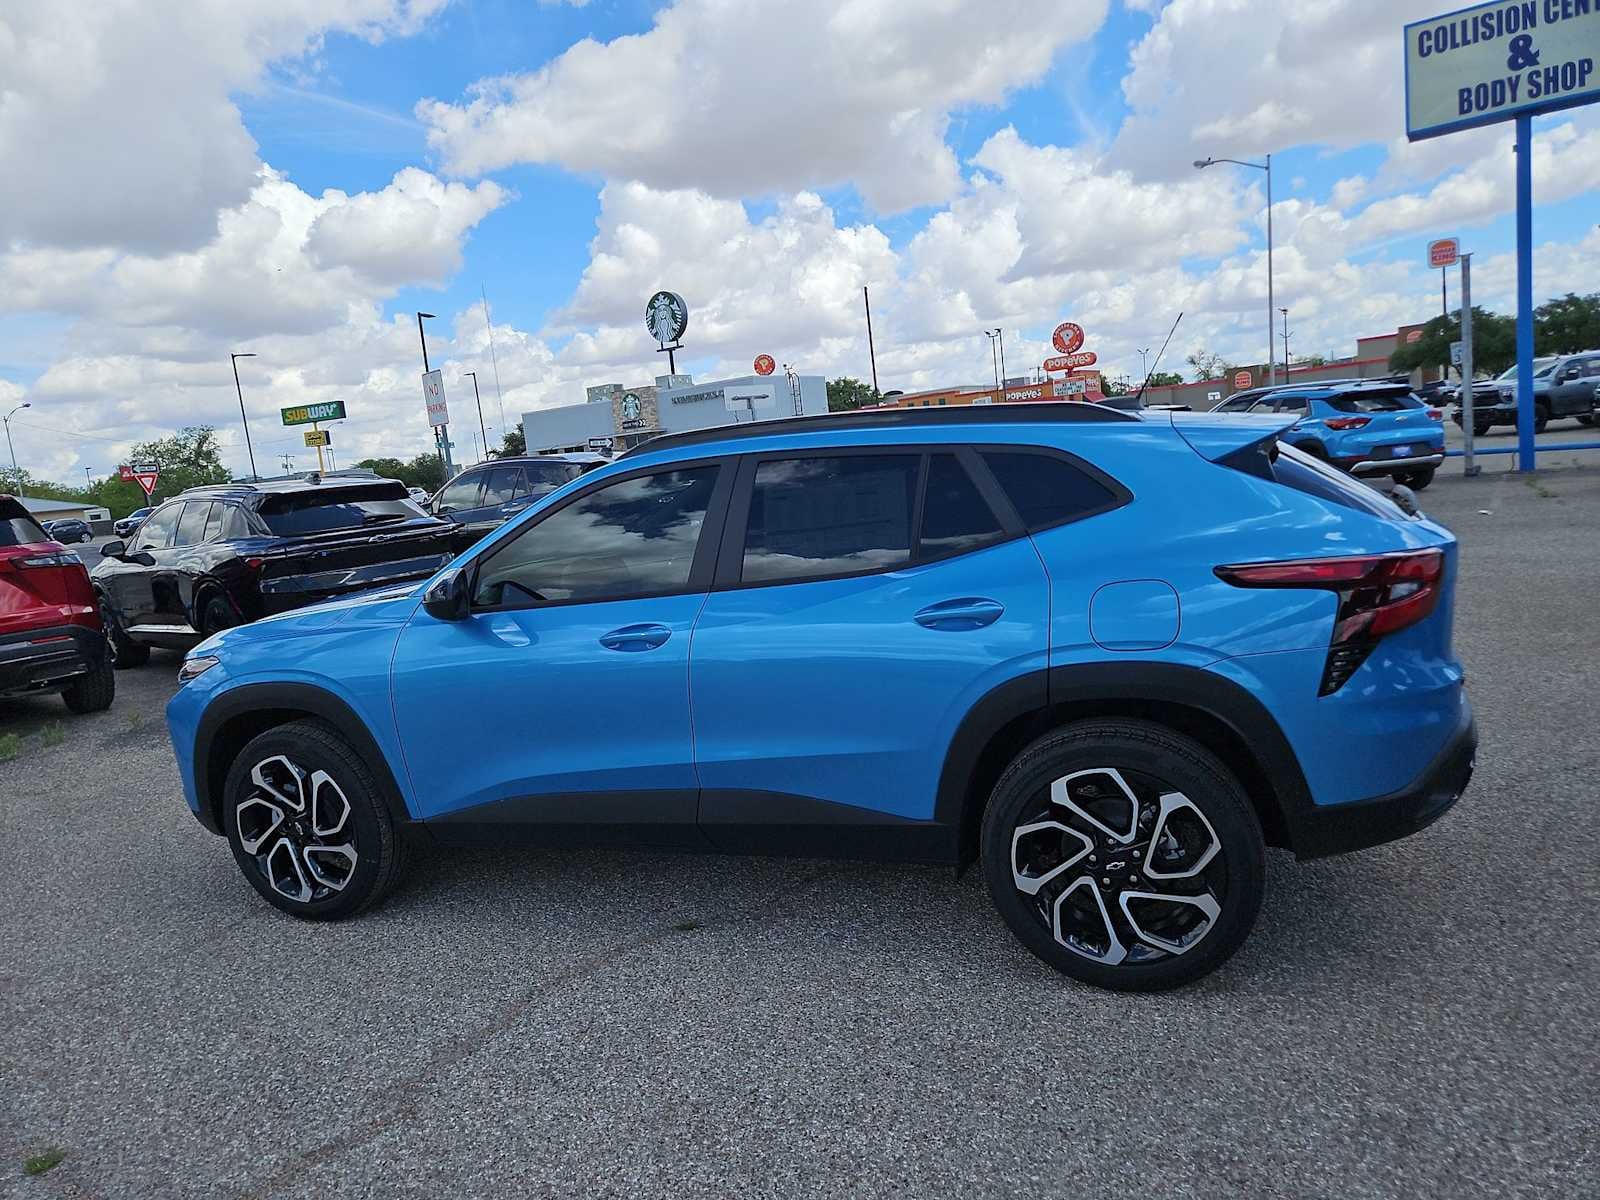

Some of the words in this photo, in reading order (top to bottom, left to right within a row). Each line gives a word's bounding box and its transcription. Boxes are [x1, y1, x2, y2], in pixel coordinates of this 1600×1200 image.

[1418, 1, 1537, 58] COLLISION
[1544, 0, 1600, 24] CEN
[1507, 34, 1540, 71] &
[1458, 75, 1521, 116] BODY
[1527, 58, 1593, 99] SHOP
[428, 383, 439, 397] NO
[286, 403, 337, 421] SUBWAY
